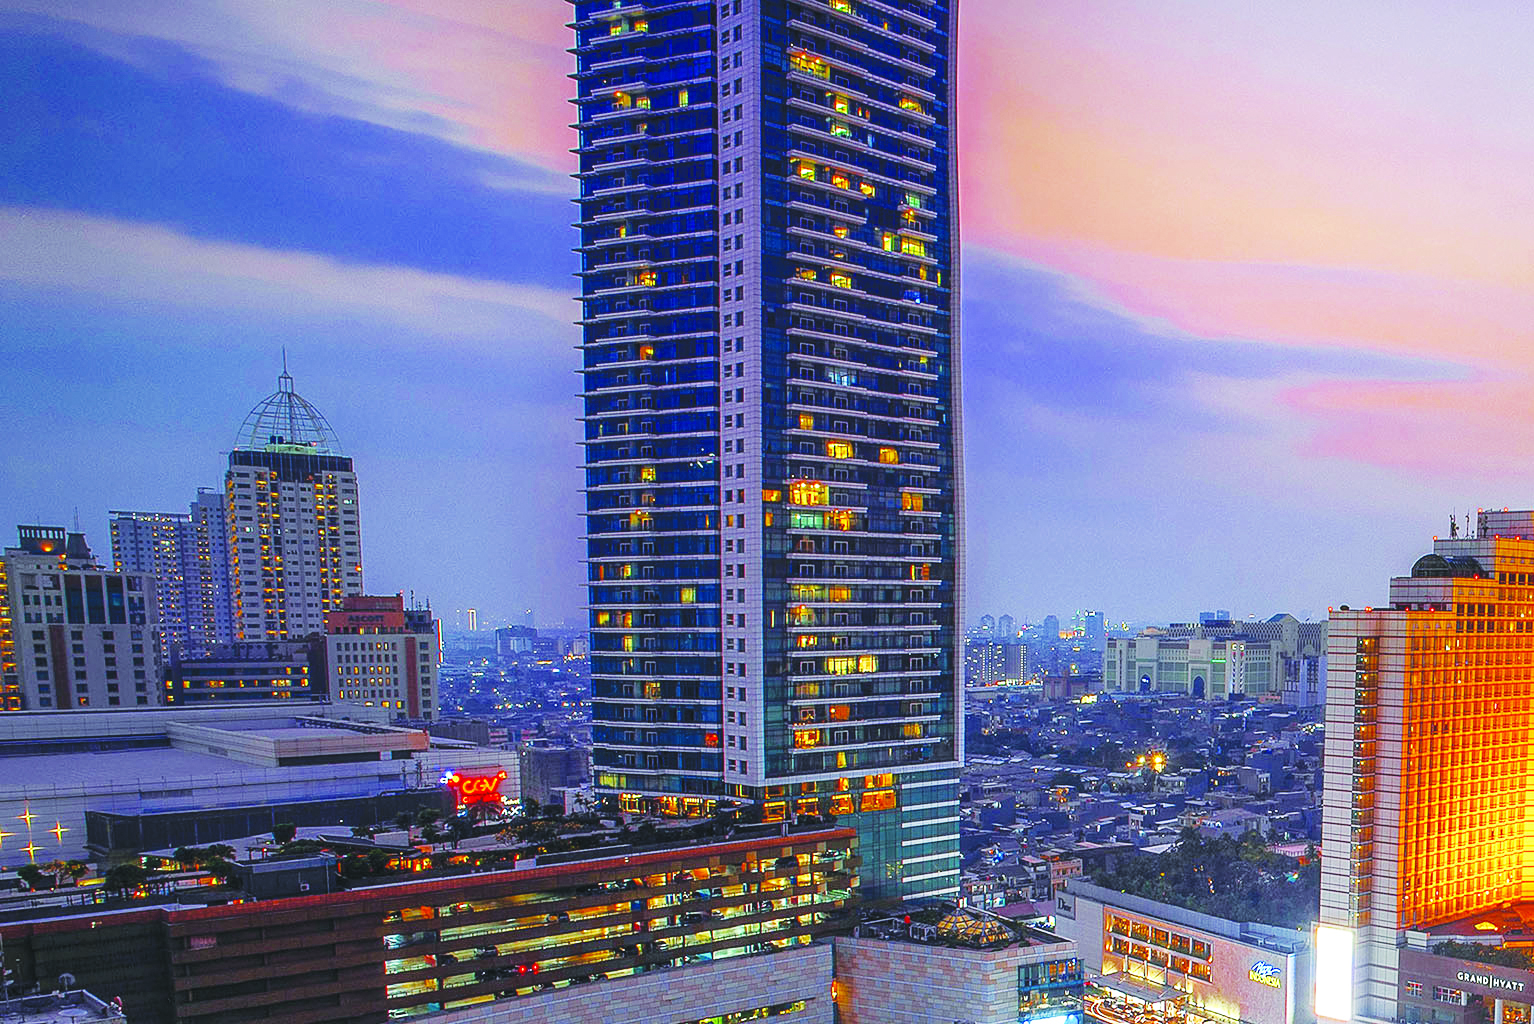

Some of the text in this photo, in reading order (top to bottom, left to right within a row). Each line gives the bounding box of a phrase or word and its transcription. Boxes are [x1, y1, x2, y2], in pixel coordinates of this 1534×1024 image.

[462, 778, 498, 794] CGV
[1457, 972, 1525, 992] GRAND HYATT
